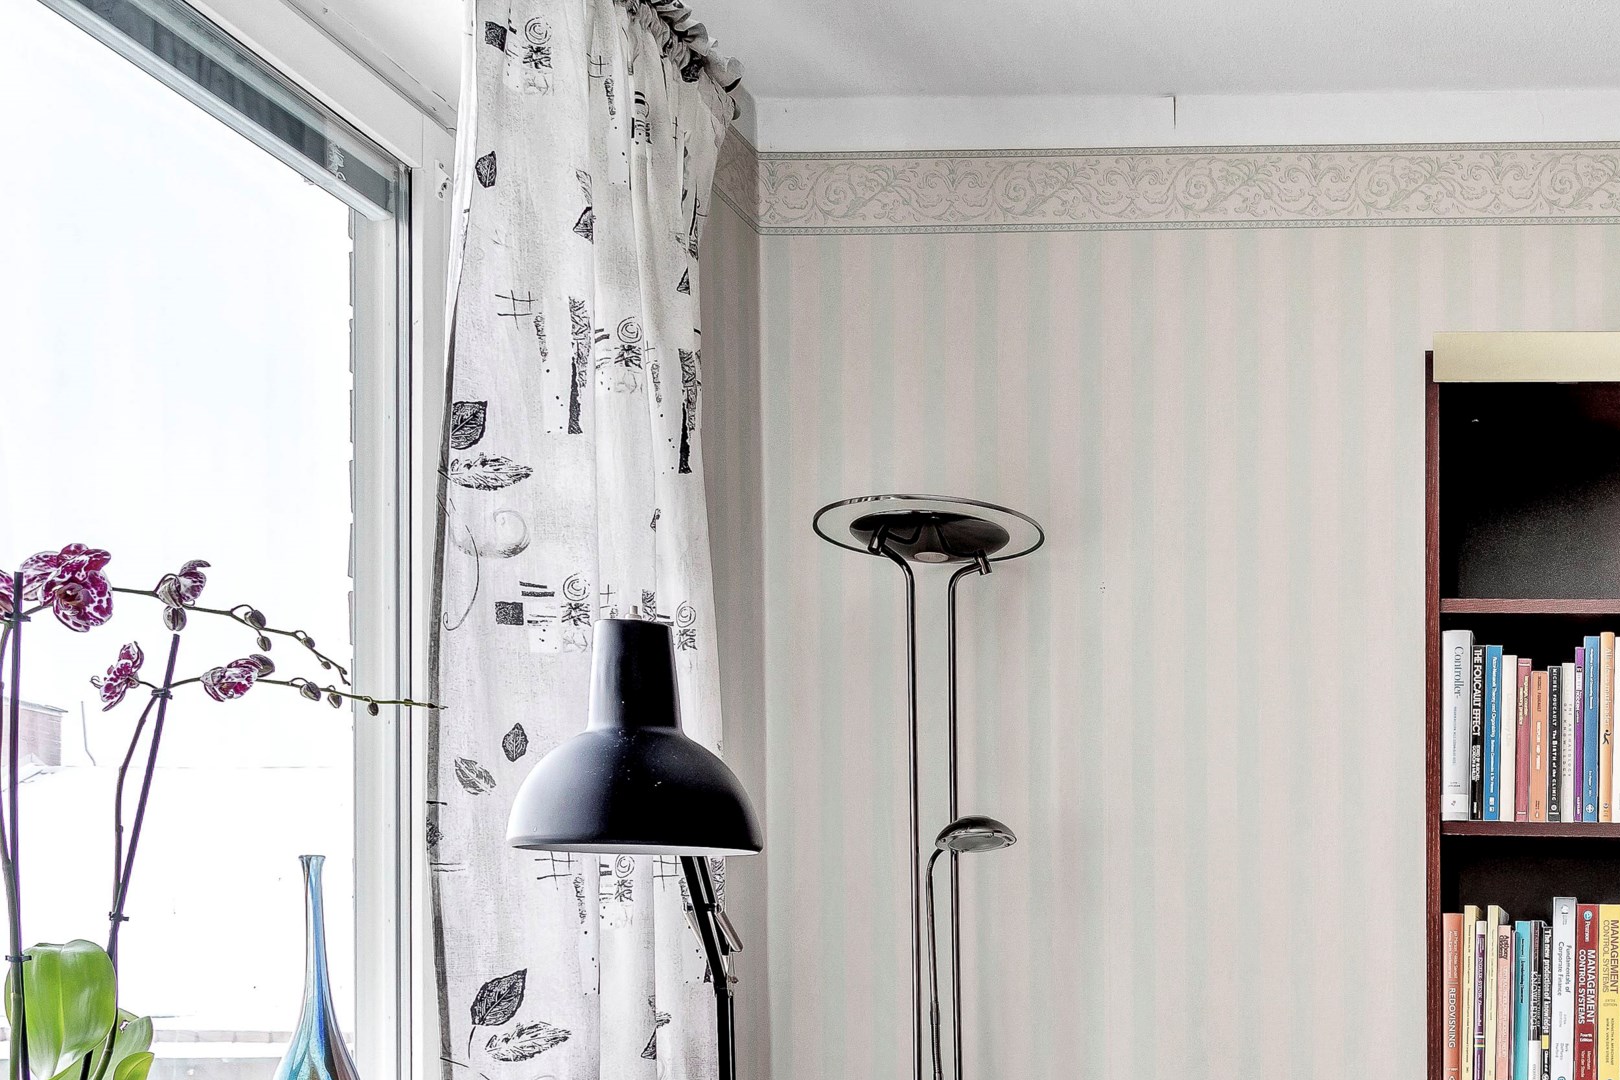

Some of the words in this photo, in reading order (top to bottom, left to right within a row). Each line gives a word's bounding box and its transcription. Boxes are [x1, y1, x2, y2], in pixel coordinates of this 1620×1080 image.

[1453, 646, 1464, 699] Controller-
[1474, 649, 1482, 663] THE
[1473, 665, 1482, 707] FOUCAULT
[1473, 708, 1482, 736] EFFECT
[1578, 949, 1586, 987] CONTROL
[1610, 919, 1619, 994] MANAGEMENT
[1544, 989, 1550, 999] of
[1586, 949, 1595, 1024] MANAGEMENT
[1448, 988, 1456, 1048] REDOVISNING
